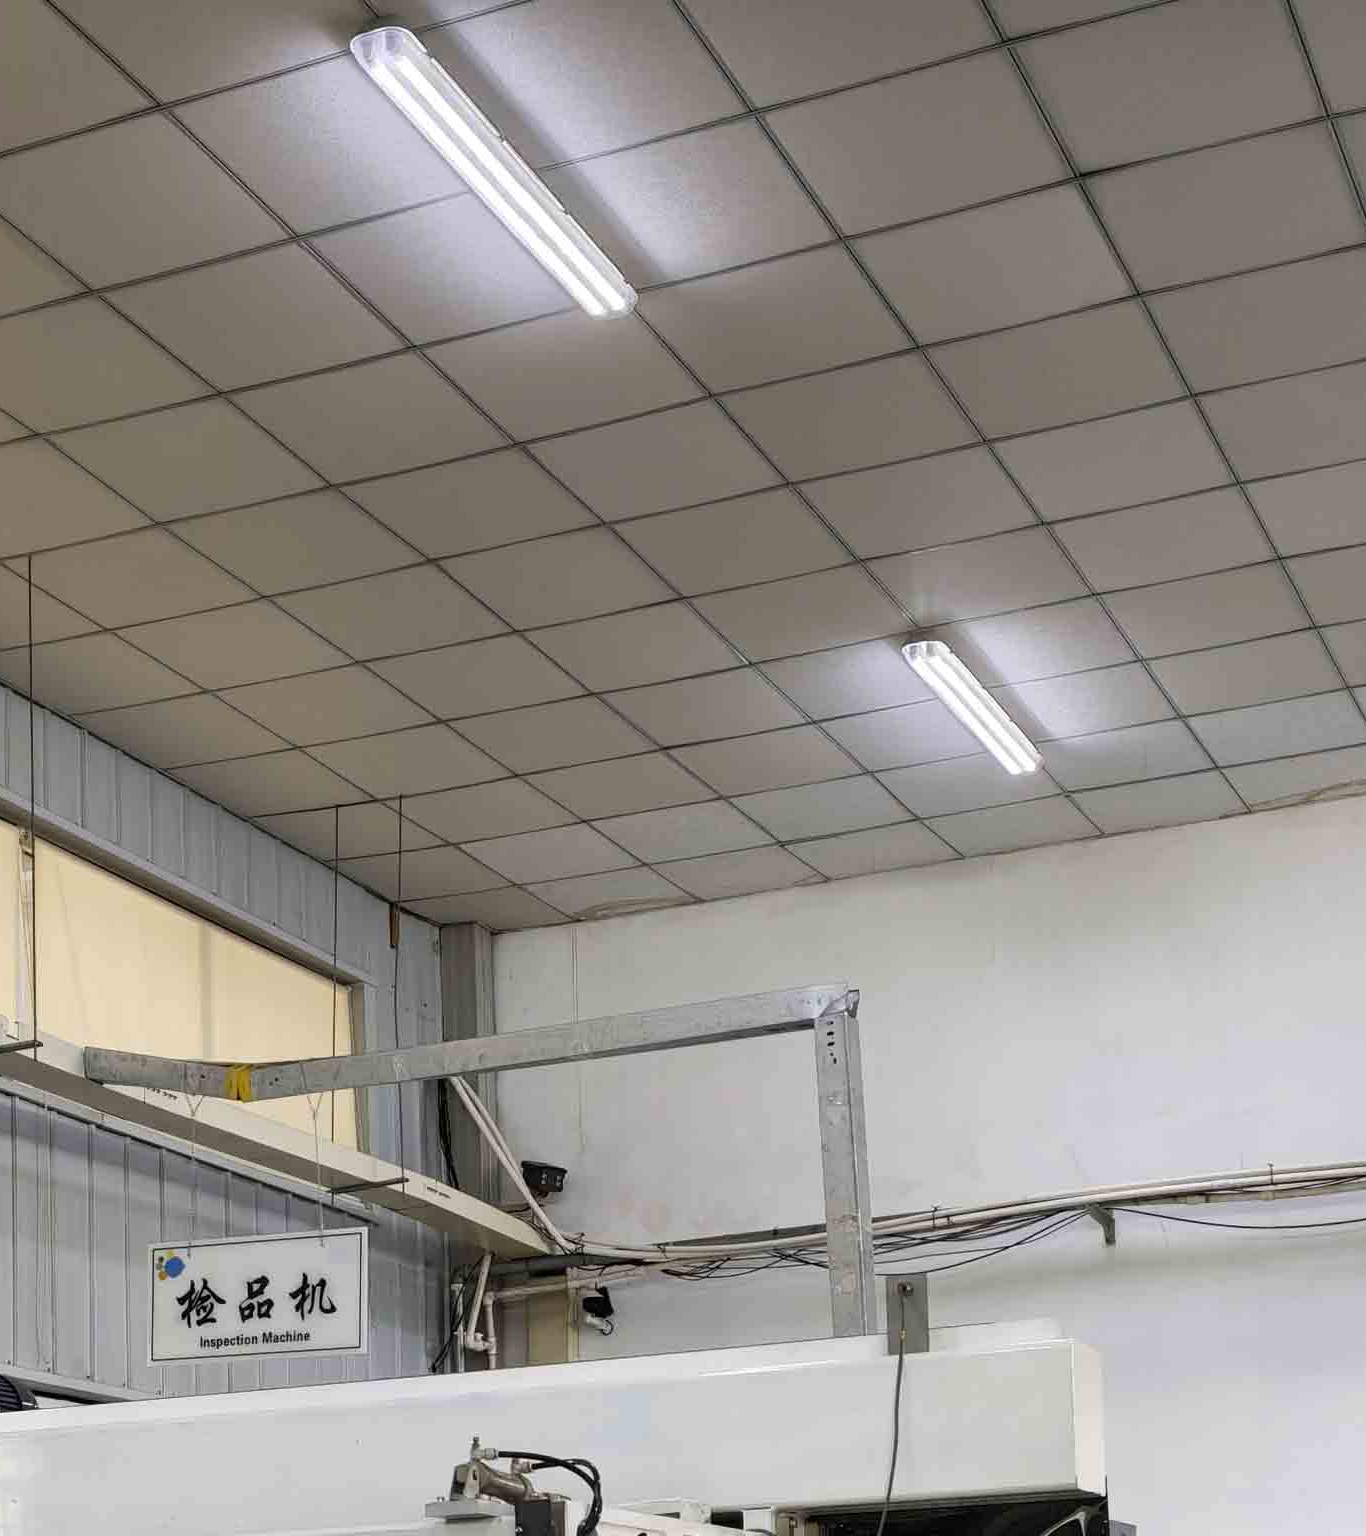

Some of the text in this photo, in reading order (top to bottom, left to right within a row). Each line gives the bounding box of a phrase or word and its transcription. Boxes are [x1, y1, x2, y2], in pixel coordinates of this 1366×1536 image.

[176, 1272, 337, 1329] 检品机
[199, 1331, 311, 1349] Inspection Machine
